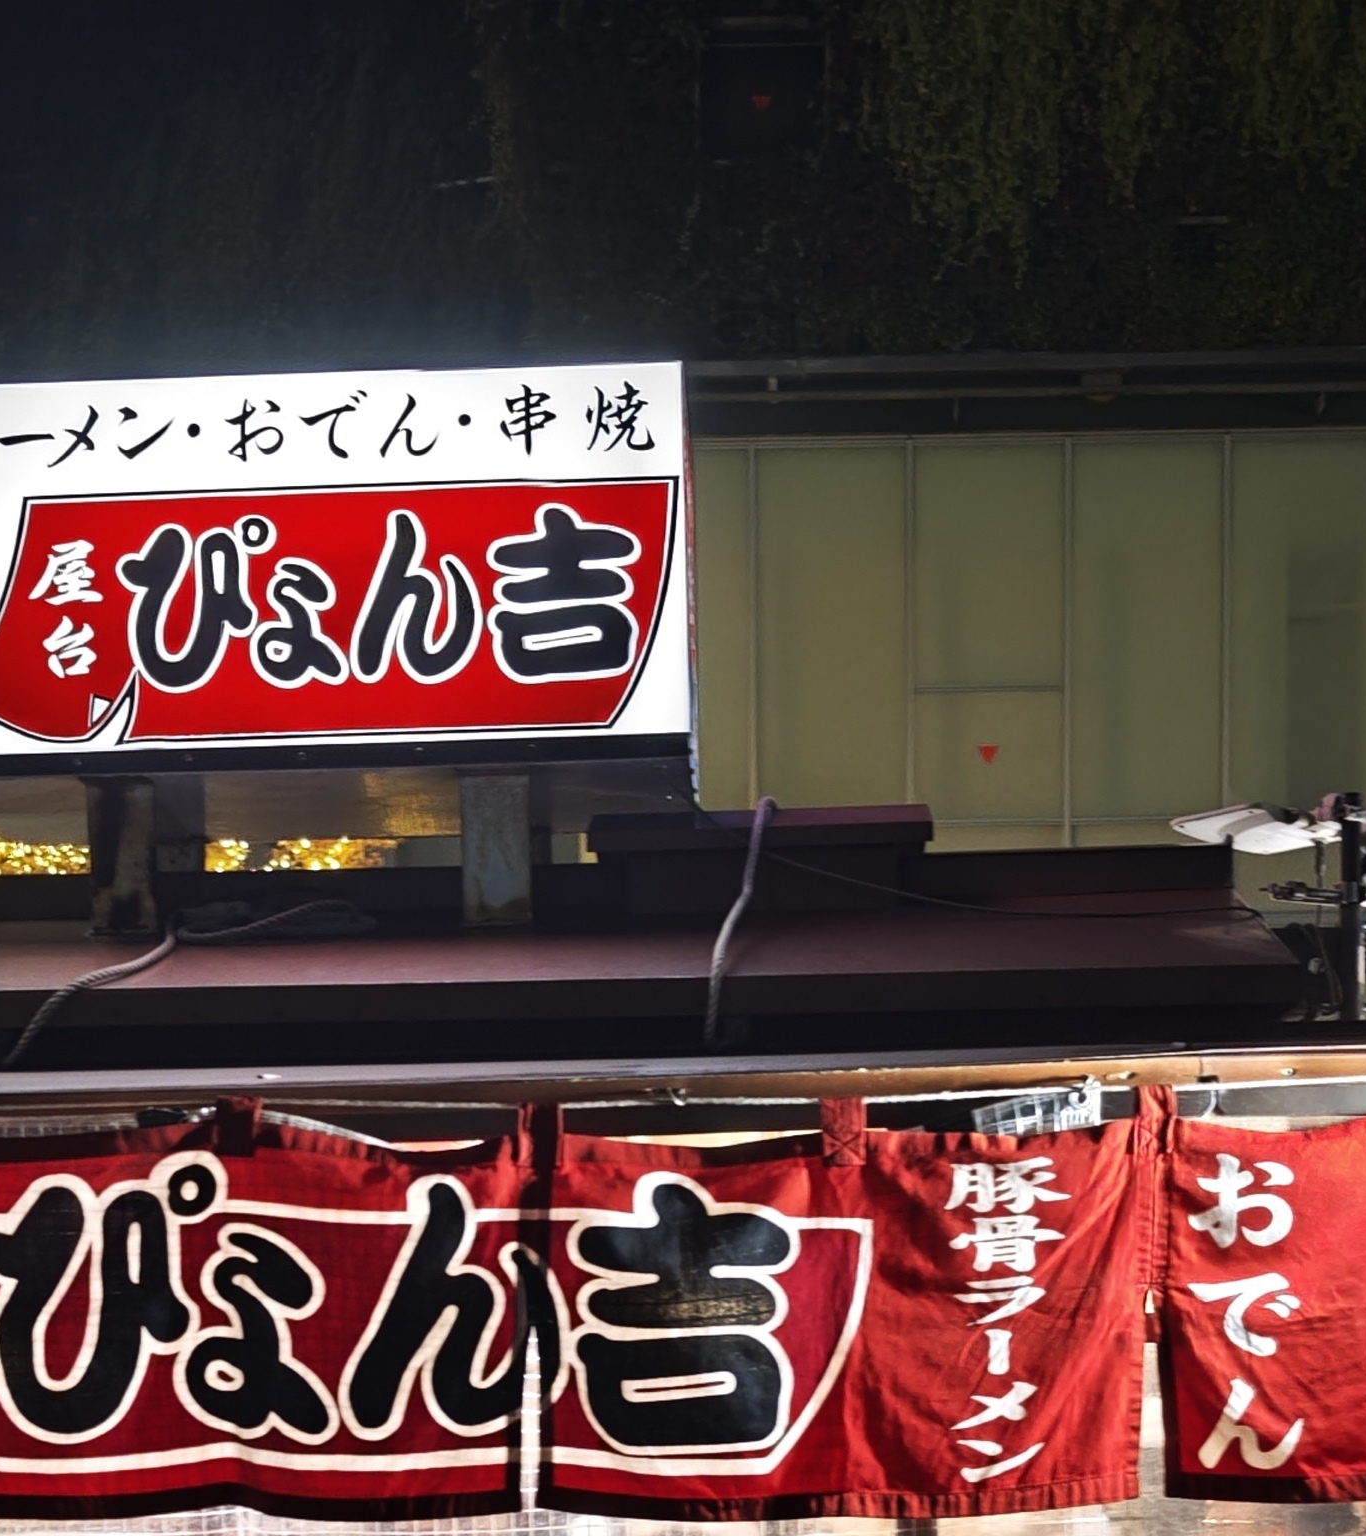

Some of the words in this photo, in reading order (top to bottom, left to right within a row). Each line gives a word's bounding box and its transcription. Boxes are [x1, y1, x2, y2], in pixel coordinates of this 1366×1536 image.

[29, 541, 104, 678] 屋台
[115, 504, 641, 692] ぴょん吉
[943, 1155, 1071, 1483] 豚骨ラーメン
[1188, 1152, 1304, 1471] おでん
